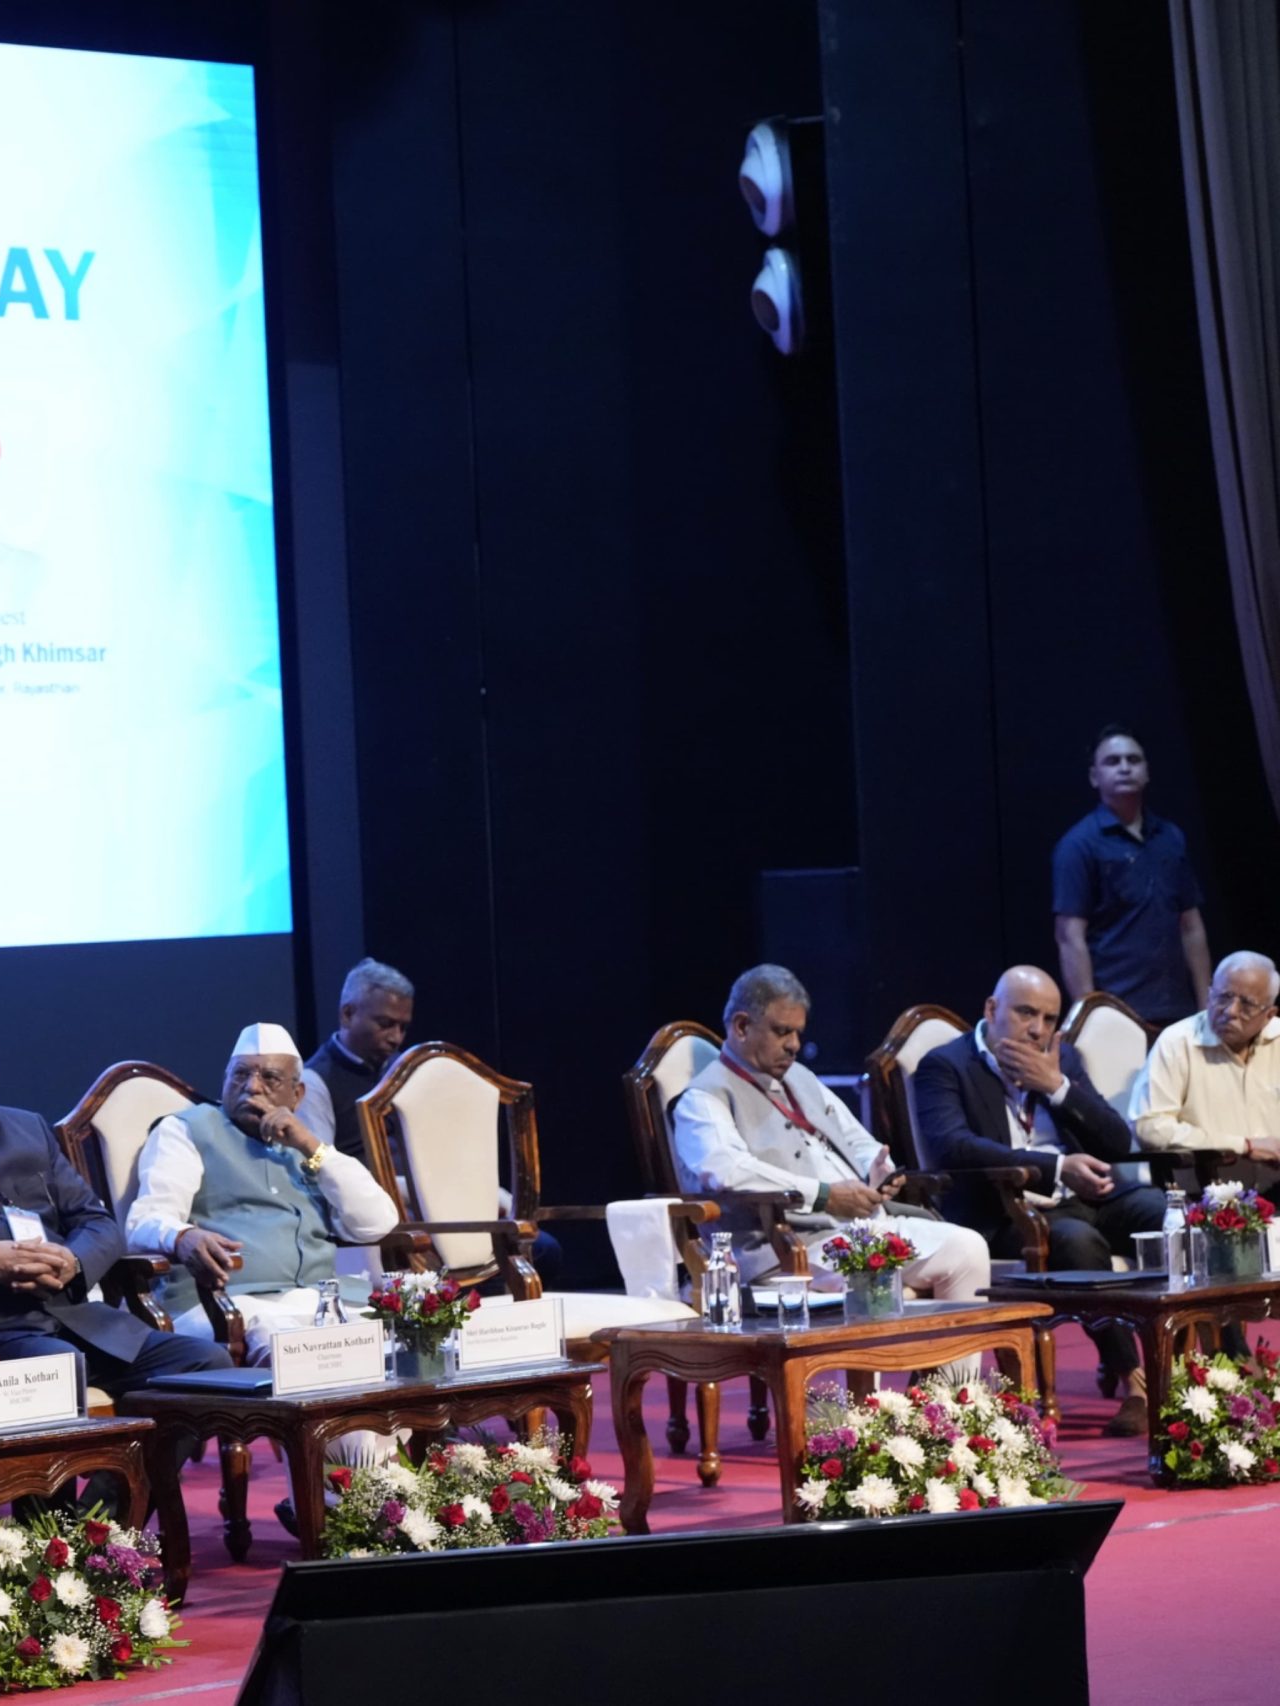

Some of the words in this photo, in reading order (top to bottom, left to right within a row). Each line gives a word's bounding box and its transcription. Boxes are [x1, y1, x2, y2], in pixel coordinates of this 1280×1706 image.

[21, 641, 108, 664] Khimsar
[283, 1343, 301, 1355] Shri
[344, 1334, 375, 1347] Kothari
[24, 1369, 59, 1385] Kothari
